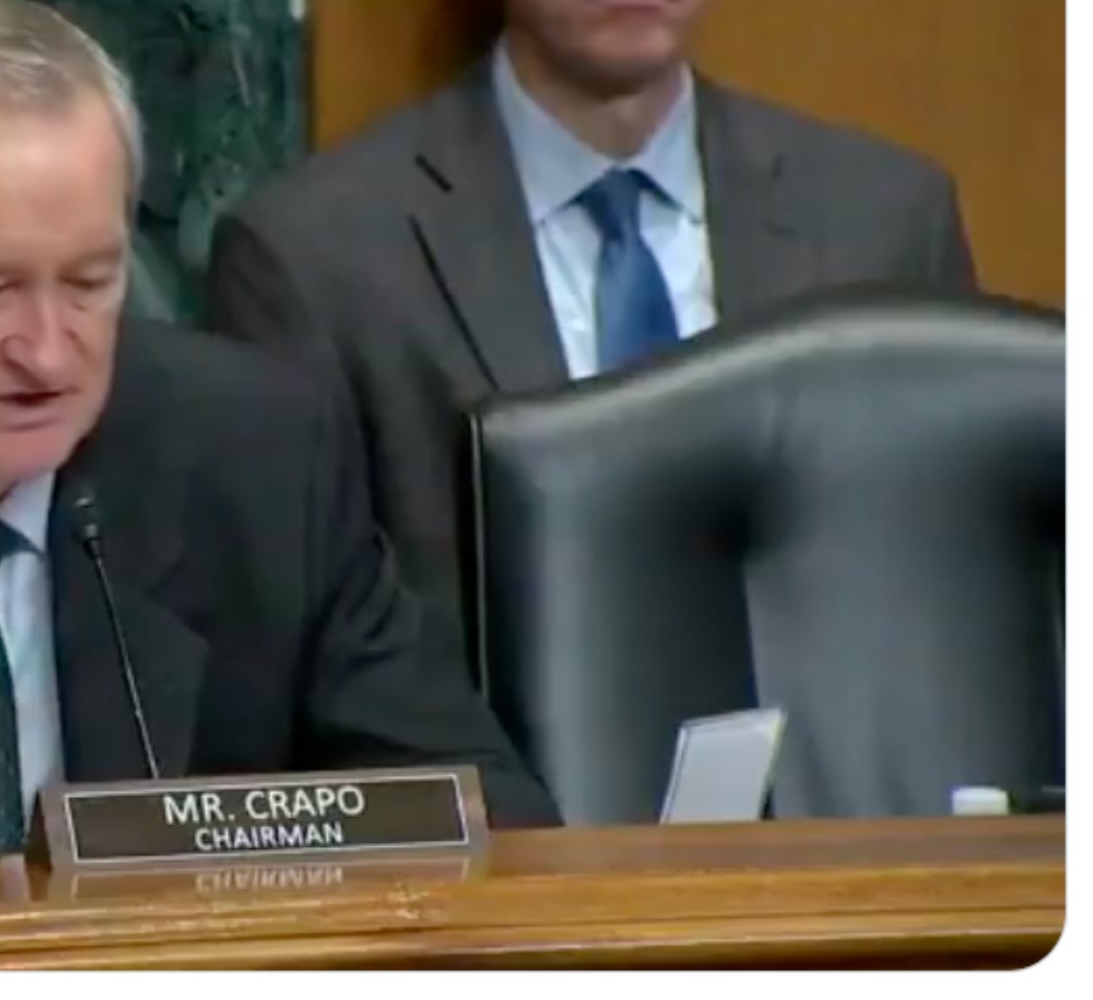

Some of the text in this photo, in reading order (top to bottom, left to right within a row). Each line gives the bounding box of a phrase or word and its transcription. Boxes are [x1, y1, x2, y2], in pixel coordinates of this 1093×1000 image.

[163, 785, 366, 825] MR. CRAPO
[194, 821, 344, 852] CHAIRMAN
